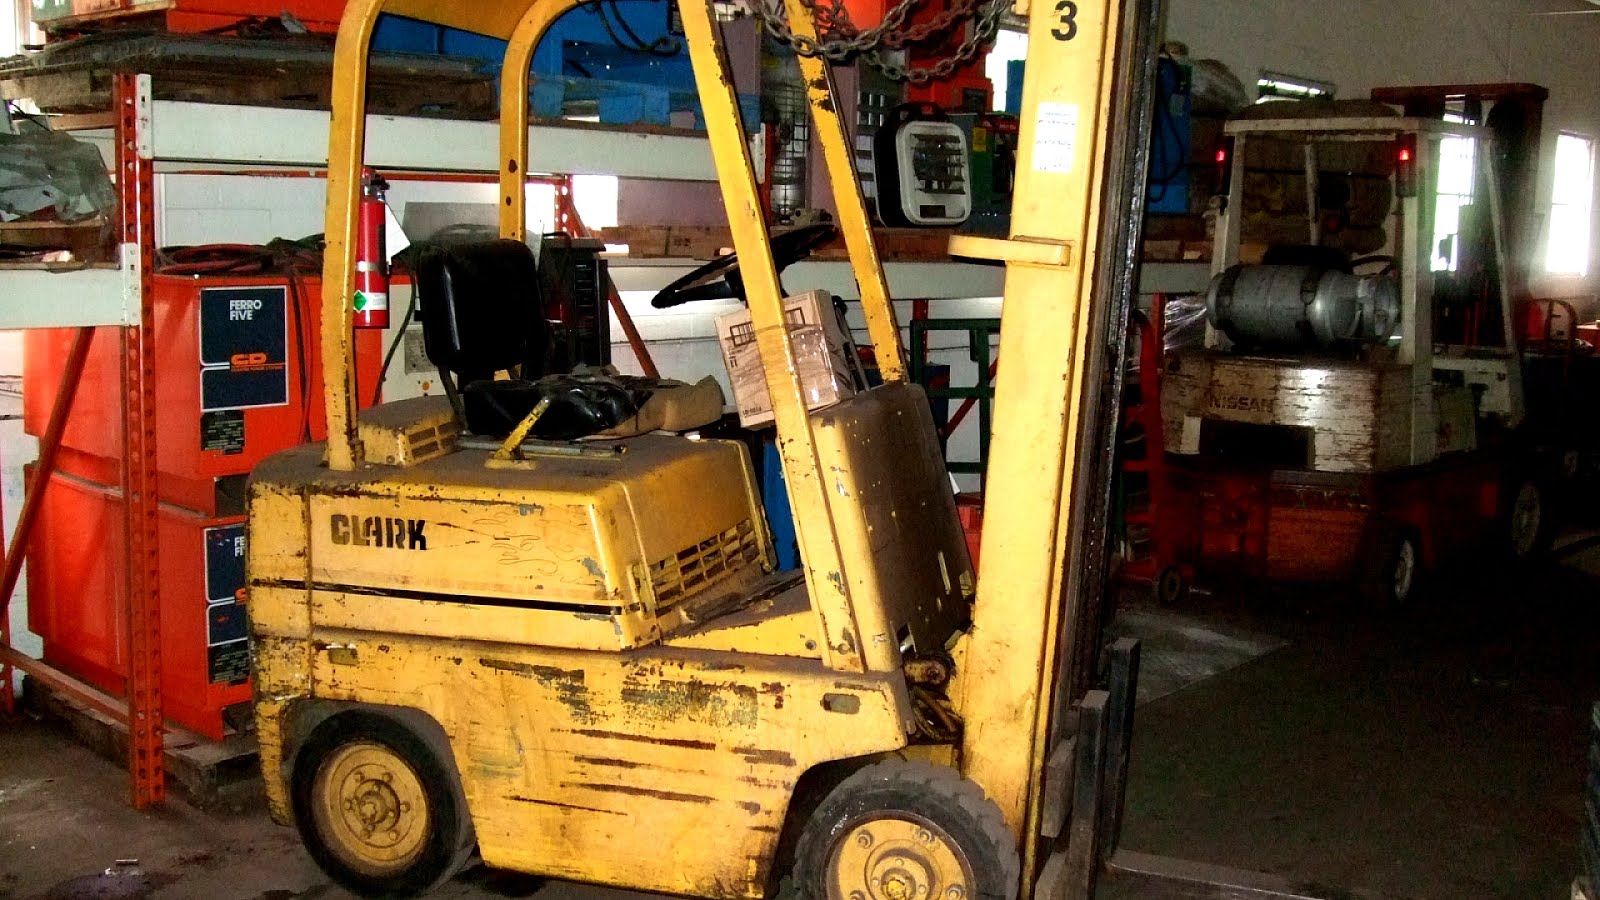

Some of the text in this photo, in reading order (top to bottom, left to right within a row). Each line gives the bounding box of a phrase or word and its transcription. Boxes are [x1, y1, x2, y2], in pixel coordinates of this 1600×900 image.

[1051, 0, 1077, 41] 3
[229, 299, 262, 310] FERRO
[229, 310, 253, 320] FIVE
[1208, 394, 1275, 413] NISSAN
[330, 514, 427, 550] CLARK
[234, 536, 246, 546] FE
[234, 546, 244, 557] FI
